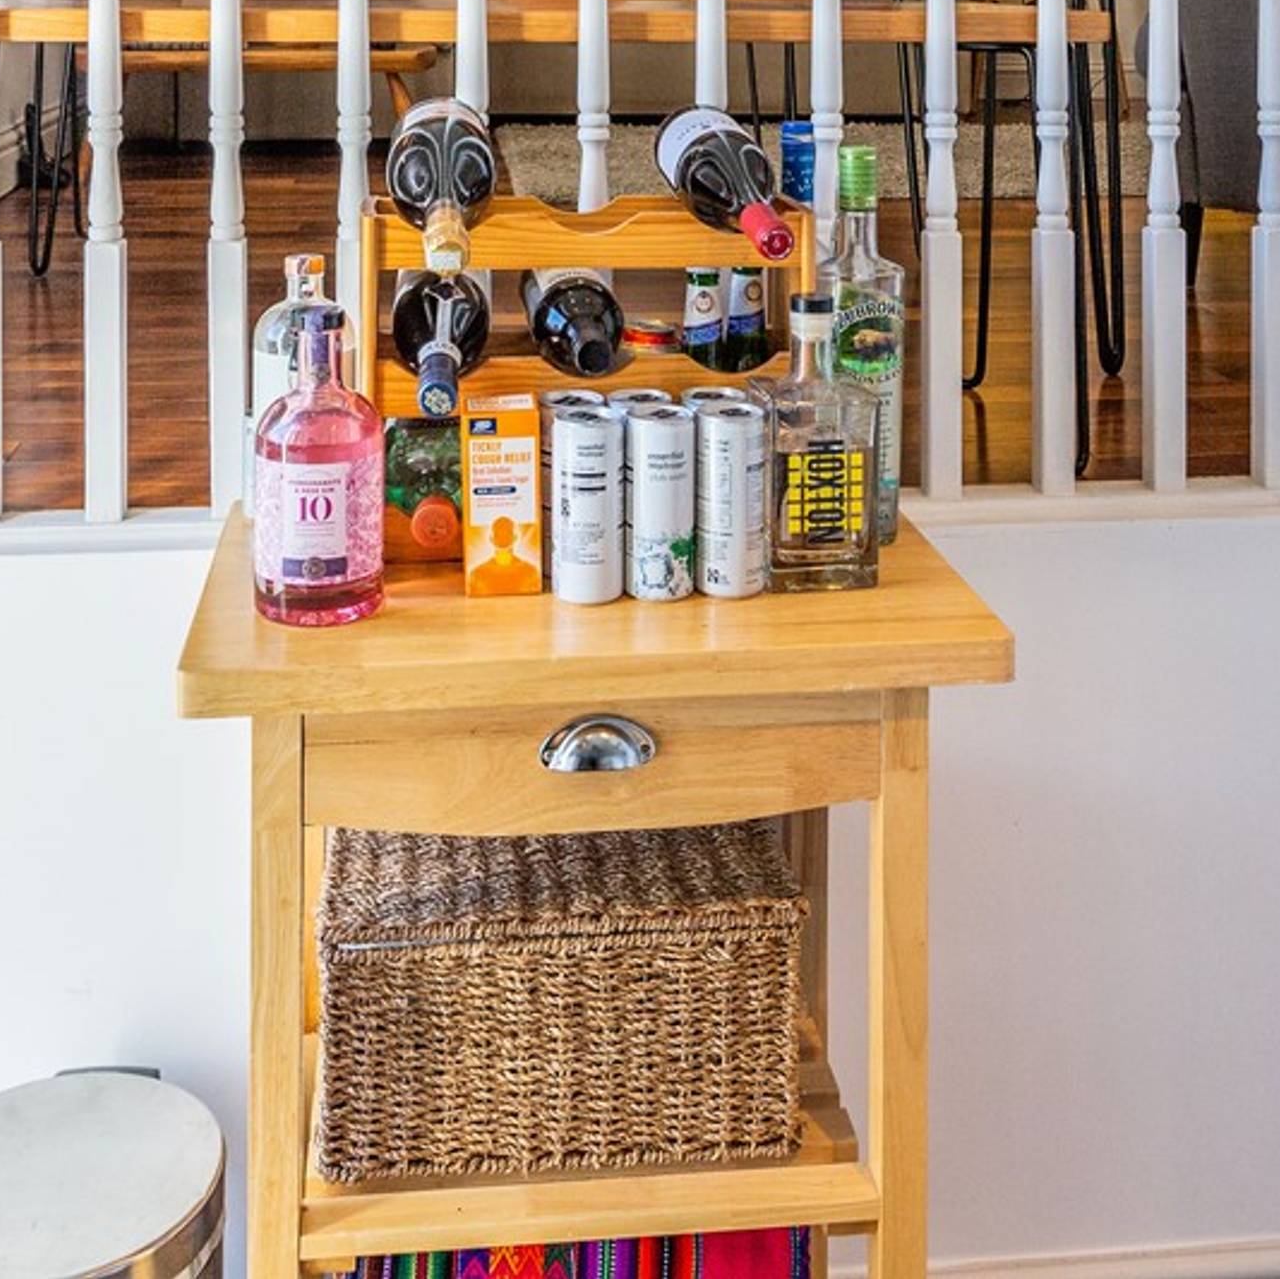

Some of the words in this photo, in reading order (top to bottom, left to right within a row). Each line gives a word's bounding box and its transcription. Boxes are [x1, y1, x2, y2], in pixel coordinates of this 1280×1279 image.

[505, 452, 531, 463] RELIEF
[807, 439, 844, 544] HOXTON
[299, 496, 332, 521] 10
